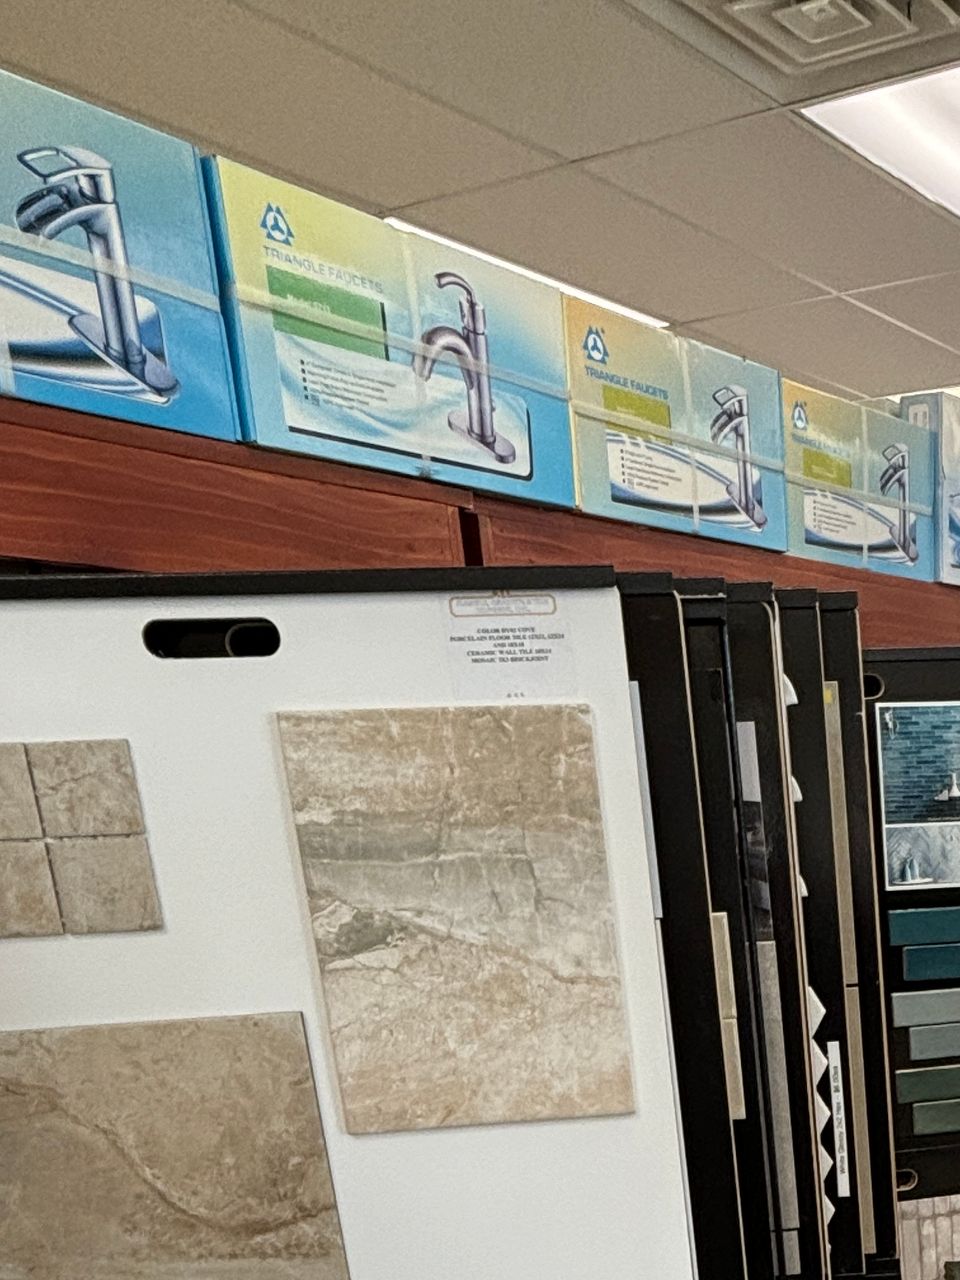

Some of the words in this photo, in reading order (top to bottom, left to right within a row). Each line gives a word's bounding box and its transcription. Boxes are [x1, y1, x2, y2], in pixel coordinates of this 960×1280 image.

[263, 245, 326, 276] TRIANGLE
[328, 266, 385, 294] FAUCETS
[584, 364, 629, 389] TRIANGLE
[630, 379, 669, 401] FAUCETS
[838, 1155, 846, 1175] White
